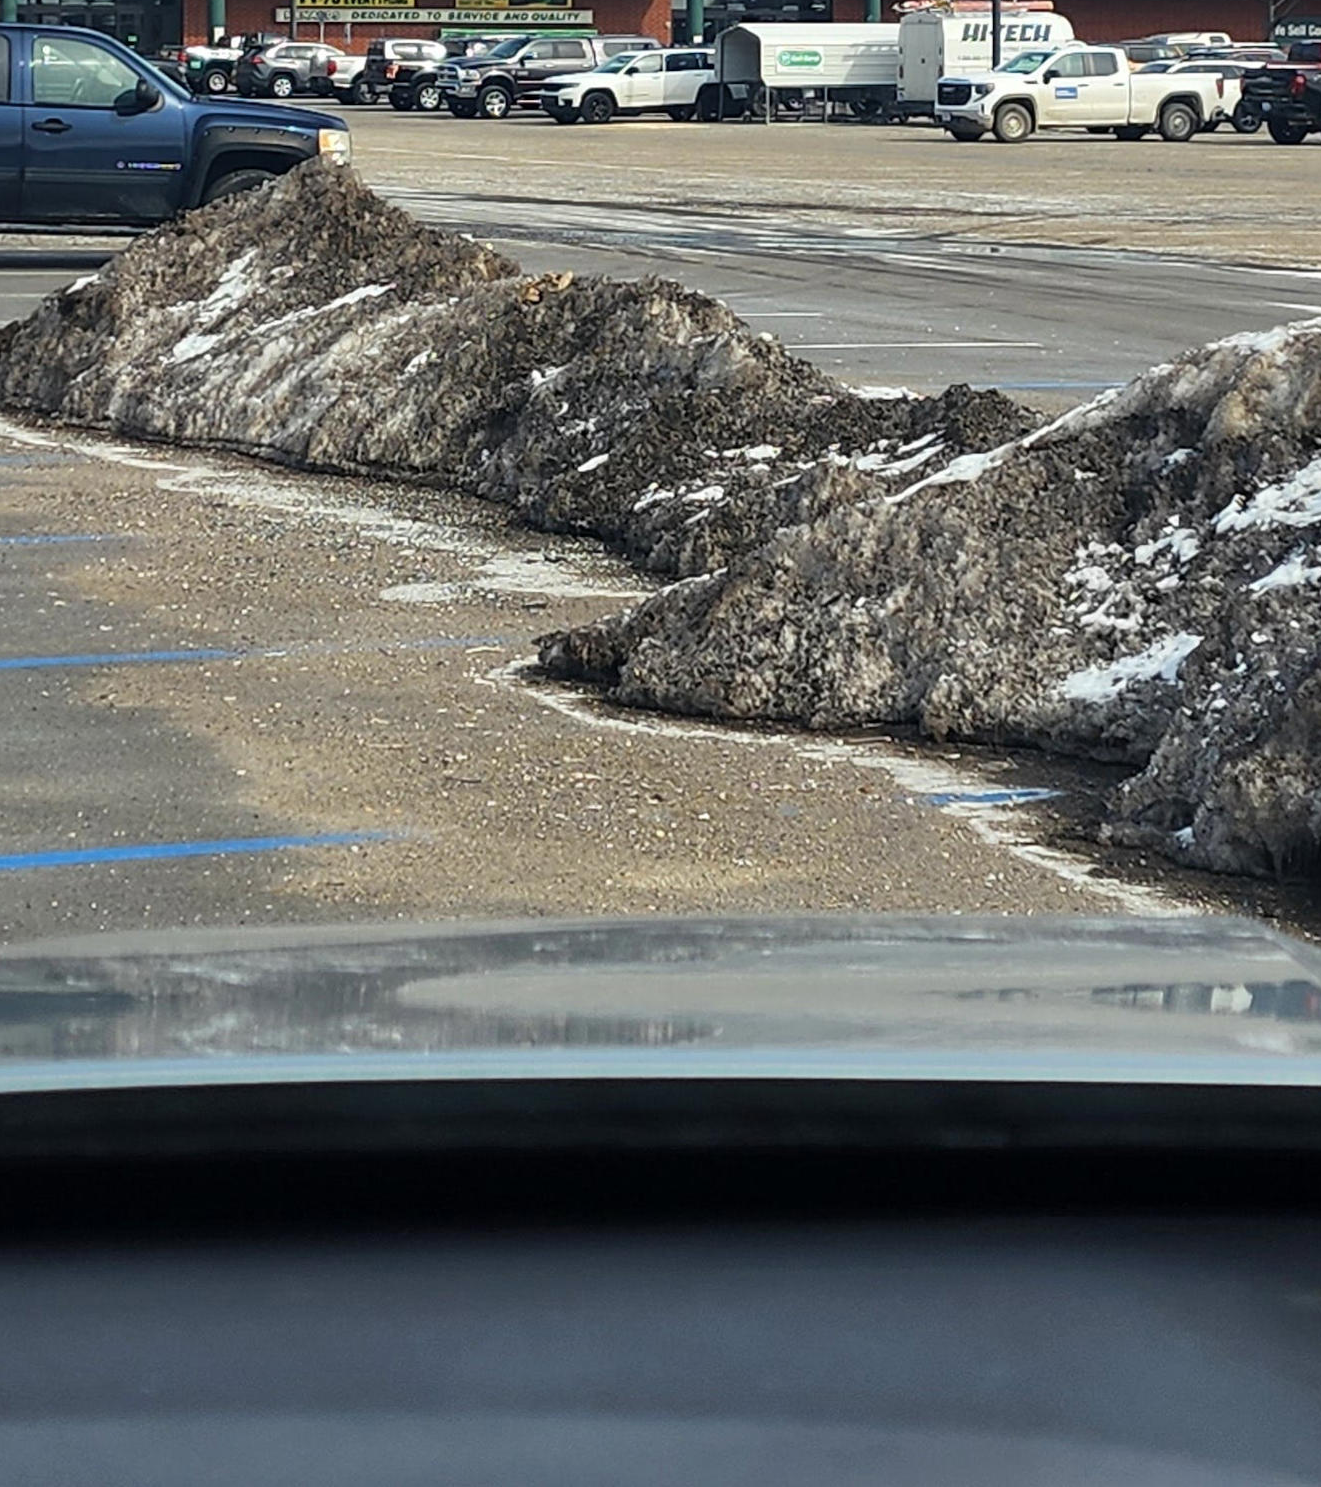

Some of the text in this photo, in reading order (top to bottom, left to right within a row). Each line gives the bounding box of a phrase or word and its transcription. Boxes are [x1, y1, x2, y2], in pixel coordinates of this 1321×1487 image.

[350, 11, 421, 20] DEDICATED
[426, 11, 442, 21] TO
[448, 11, 499, 21] SERVICE
[503, 11, 529, 21] AND
[531, 11, 581, 22] QUALITY
[1287, 23, 1307, 36] Sell
